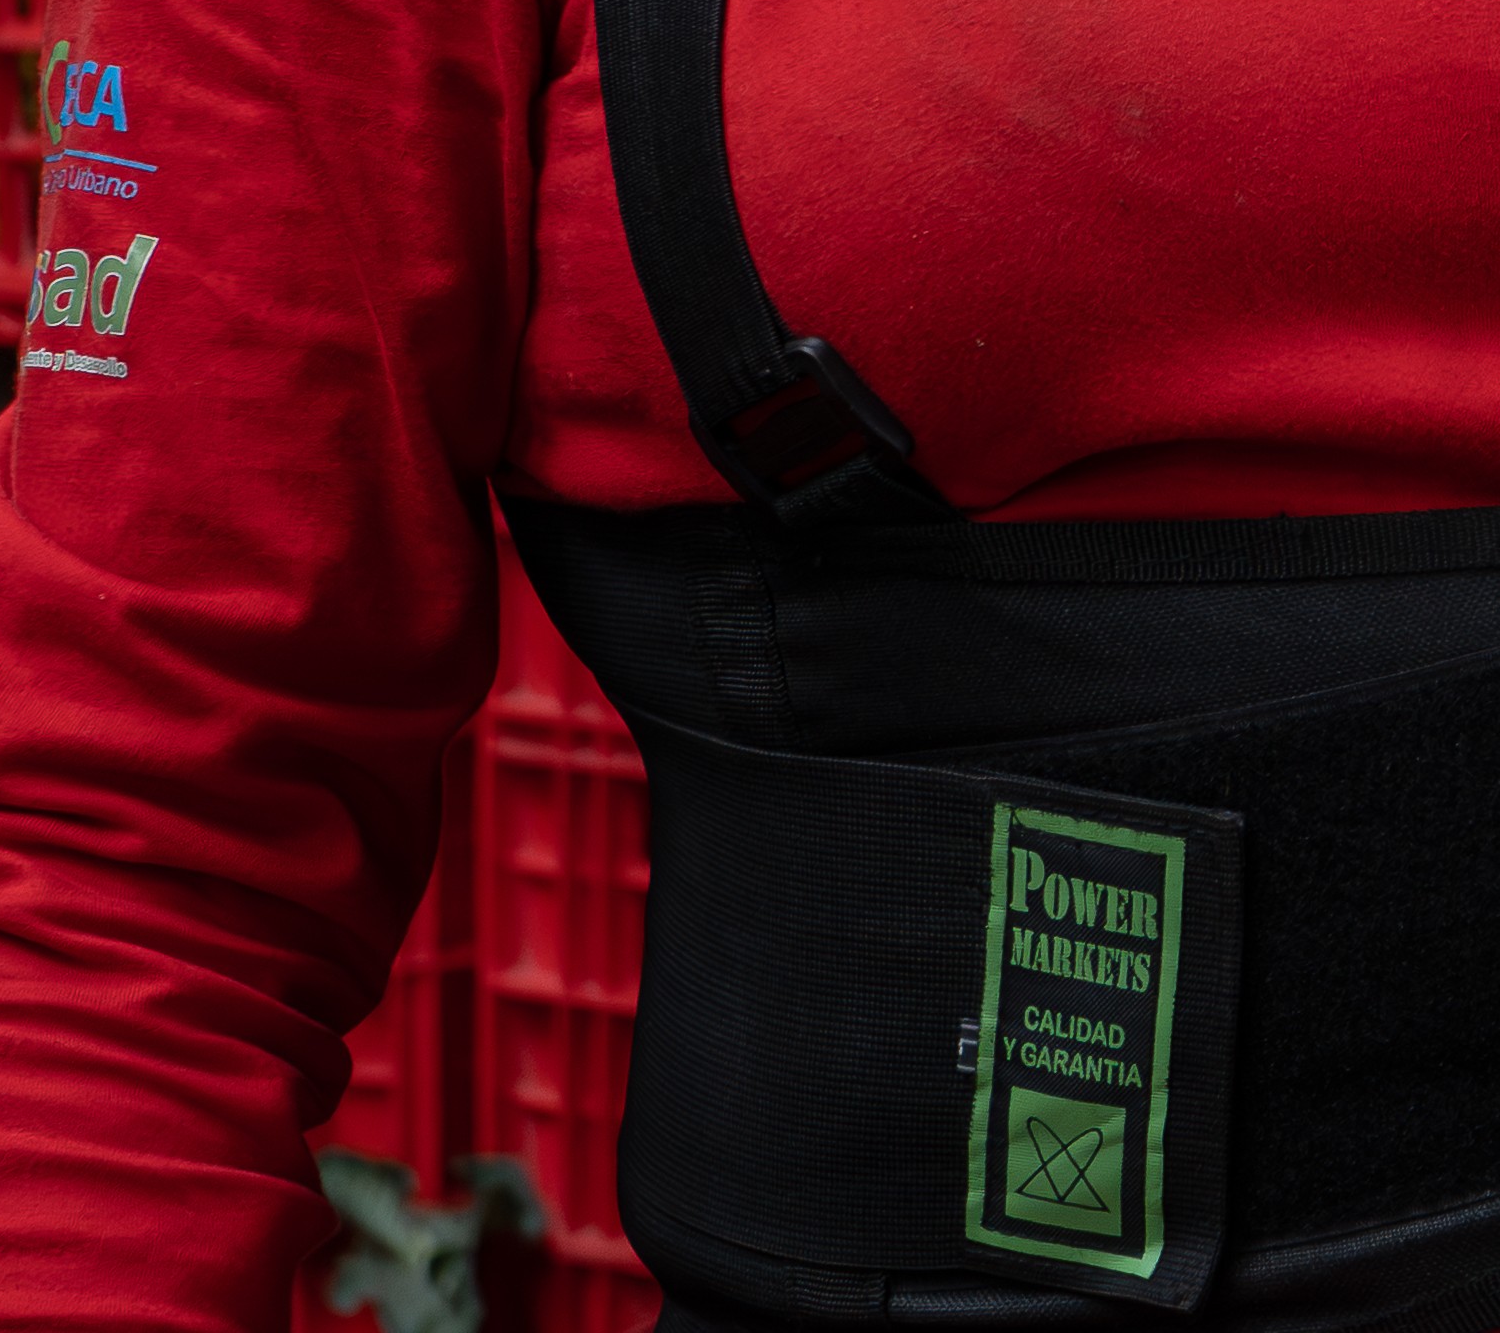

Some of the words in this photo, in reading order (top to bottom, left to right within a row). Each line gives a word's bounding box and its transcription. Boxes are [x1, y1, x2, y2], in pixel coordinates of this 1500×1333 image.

[67, 164, 139, 200] Urbano
[1009, 927, 1152, 994] MARKETS
[1023, 1005, 1127, 1050] CALIDAD
[1003, 1036, 1017, 1062] Y
[1019, 1040, 1145, 1089] GARANTIA
